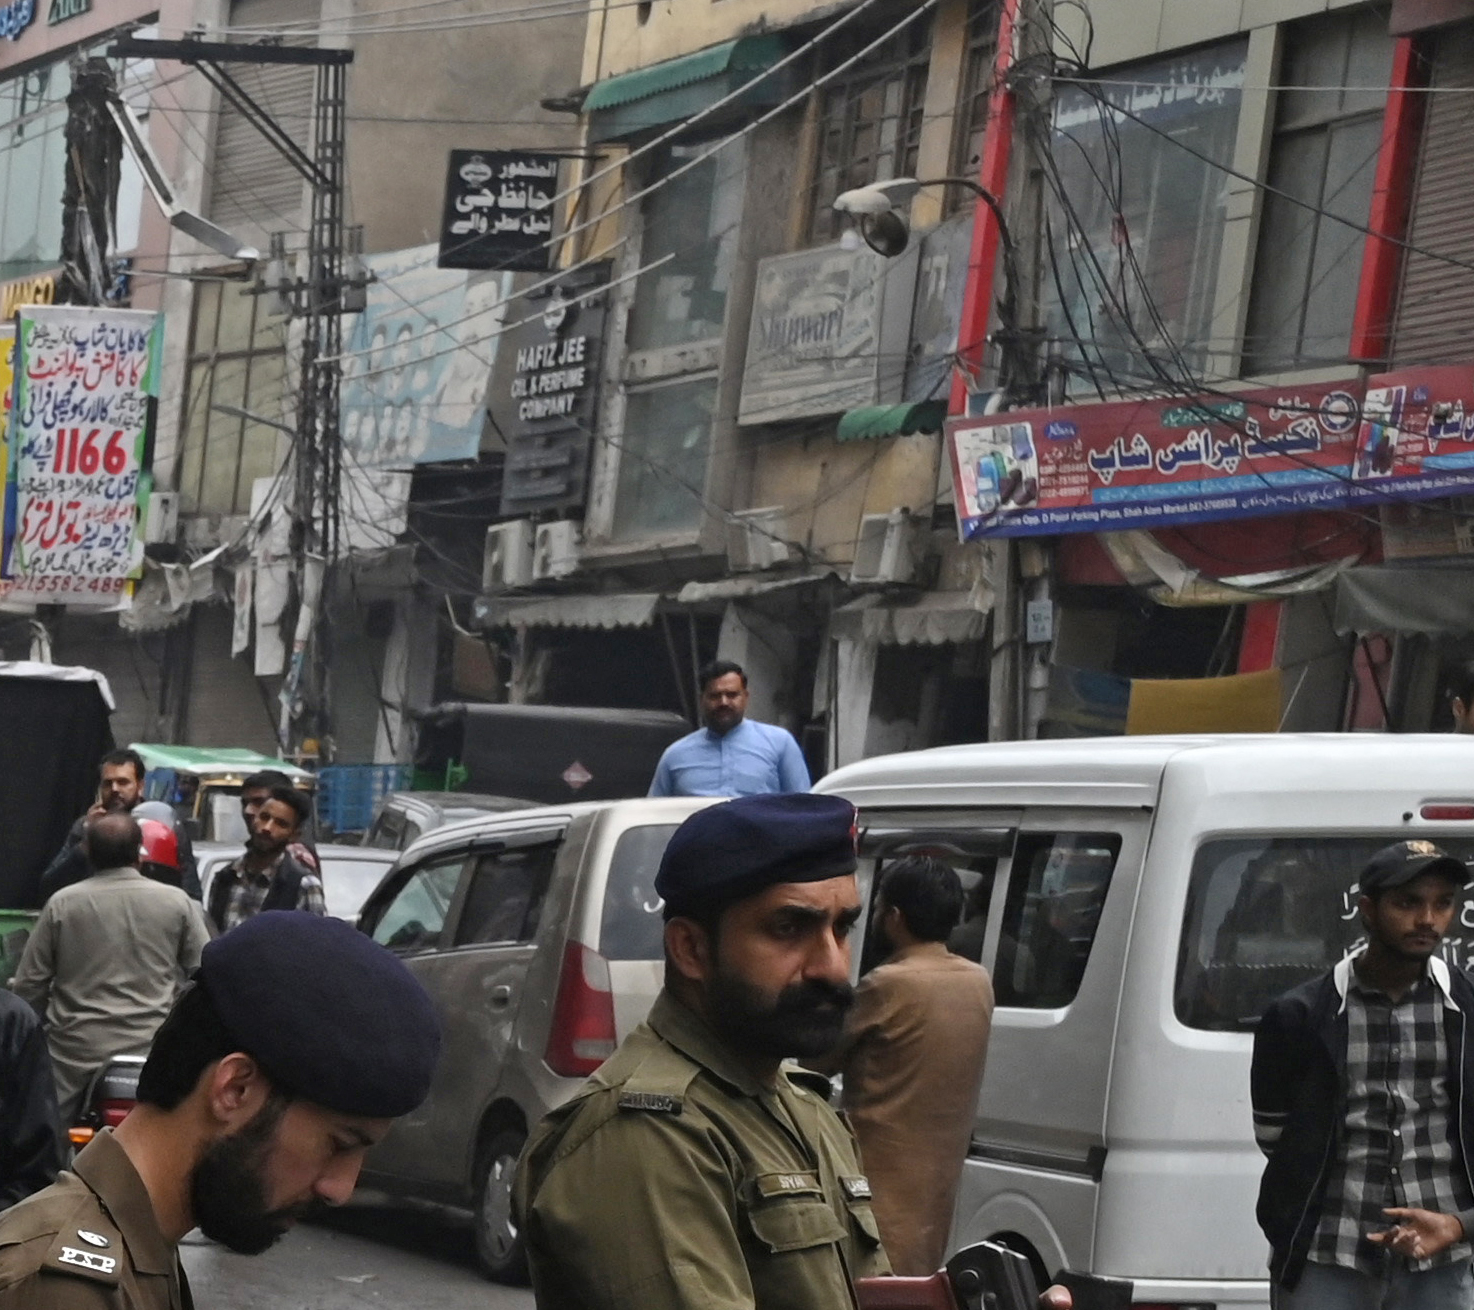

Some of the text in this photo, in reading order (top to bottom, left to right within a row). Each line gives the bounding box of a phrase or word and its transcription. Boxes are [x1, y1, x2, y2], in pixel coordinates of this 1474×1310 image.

[515, 335, 587, 373] HAFIZ JEE
[538, 367, 586, 394] PERFUME
[519, 393, 576, 421] COMPANY
[52, 428, 126, 475] 1166
[1088, 433, 1154, 485] شاپ
